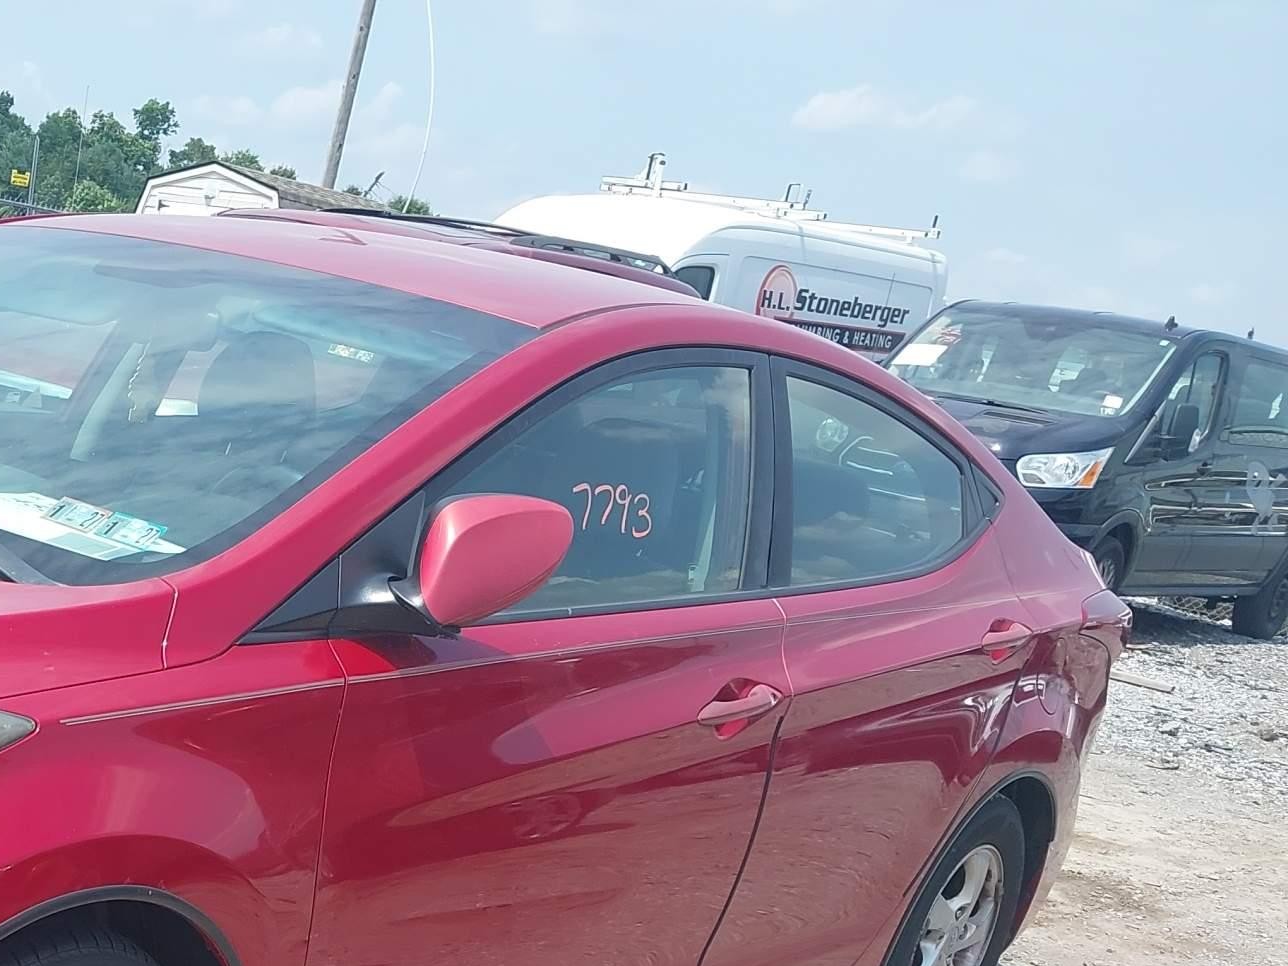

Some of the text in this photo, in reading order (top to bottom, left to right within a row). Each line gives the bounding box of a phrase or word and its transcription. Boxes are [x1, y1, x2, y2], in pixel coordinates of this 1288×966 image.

[761, 288, 909, 328] H.L. Stoneberger
[843, 331, 850, 344] &
[852, 331, 892, 348] HEATING
[572, 482, 652, 538] 7793
